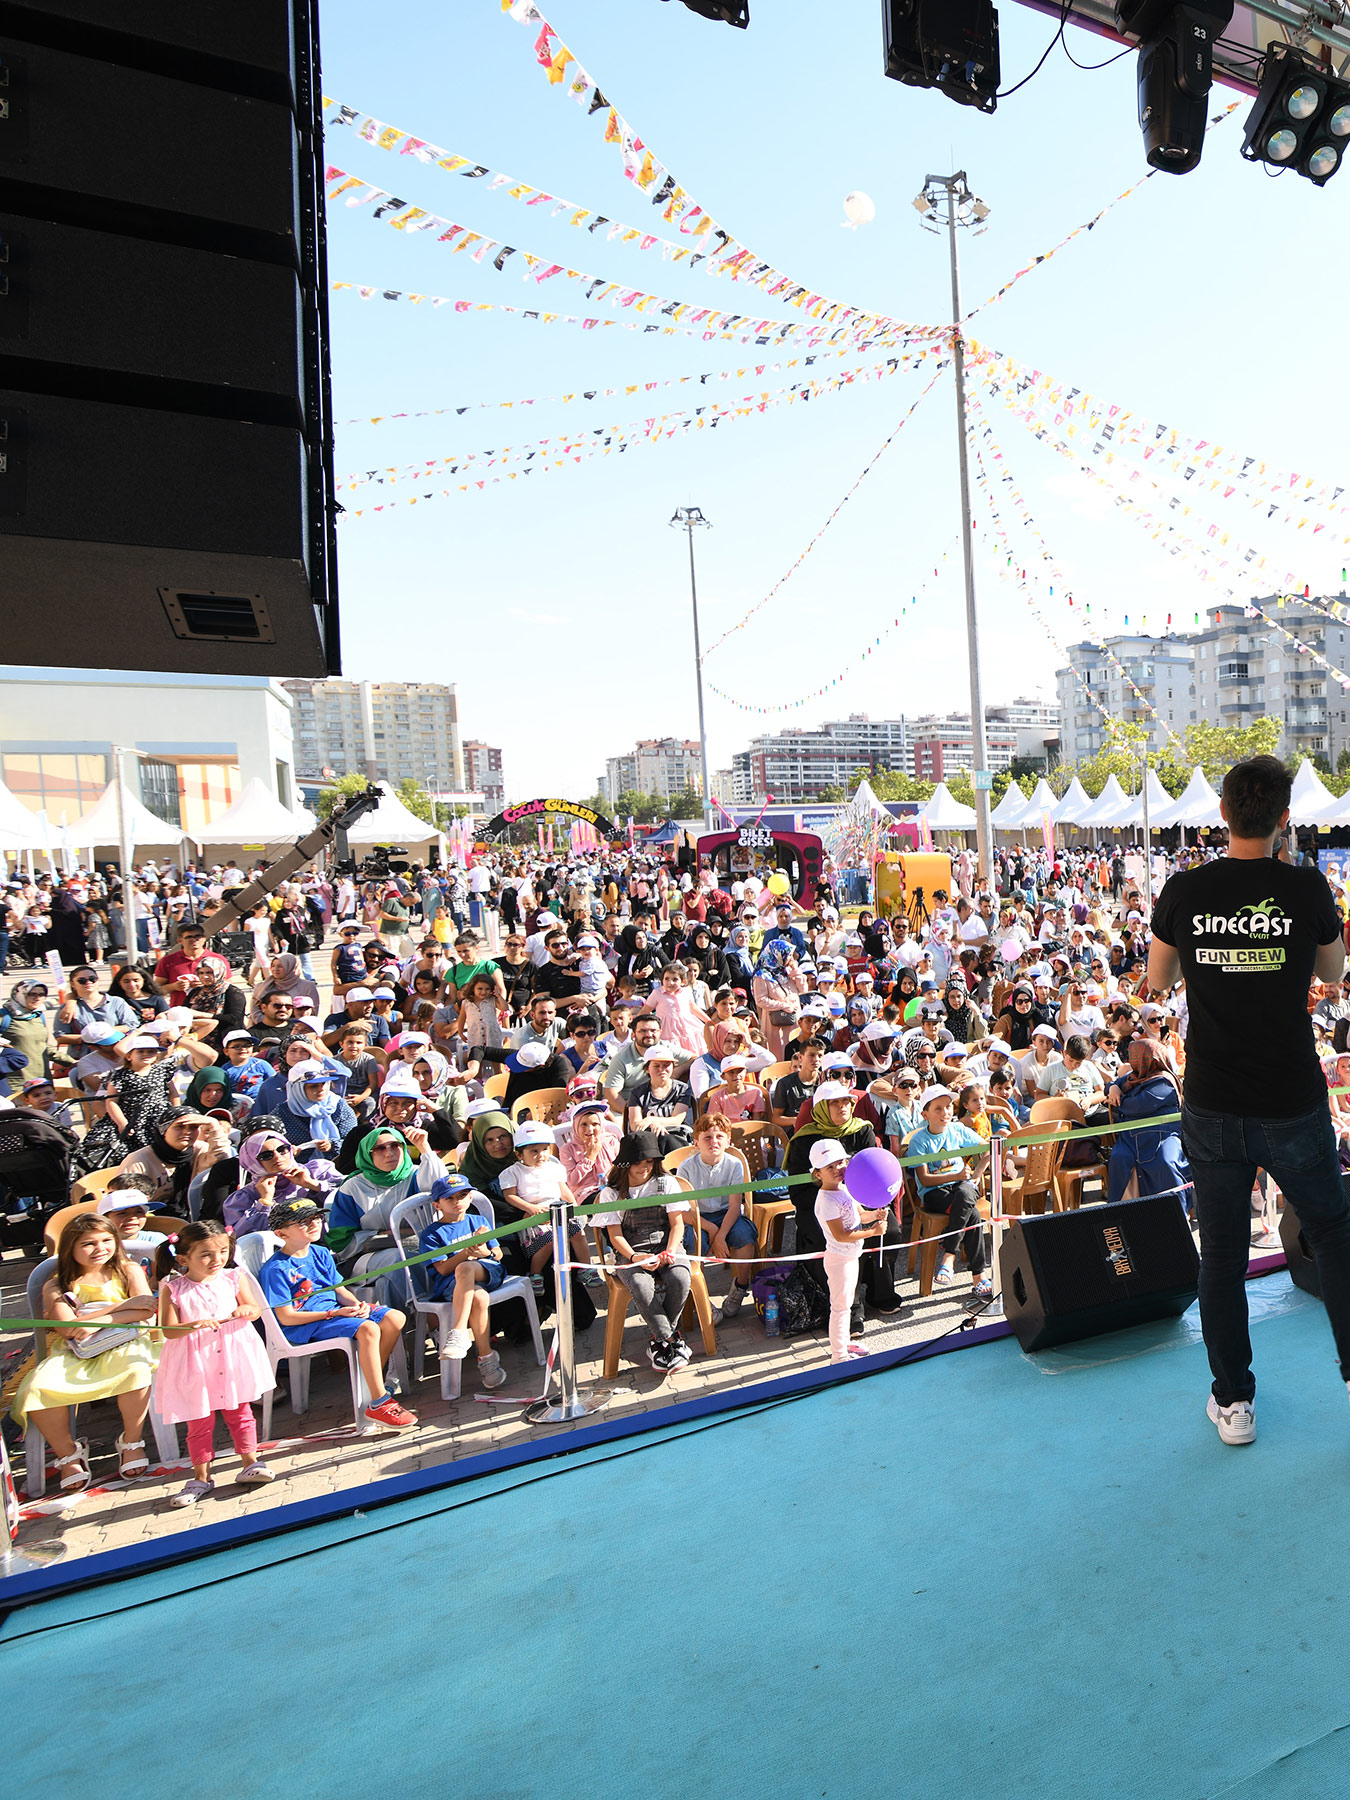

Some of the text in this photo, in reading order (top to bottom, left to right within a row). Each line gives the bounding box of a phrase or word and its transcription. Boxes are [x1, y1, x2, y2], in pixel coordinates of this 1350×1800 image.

[1193, 26, 1207, 39] 23
[977, 774, 991, 785] H2
[740, 828, 773, 838] BİLET
[737, 837, 774, 847] GİŞESİ
[1199, 949, 1283, 963] FUN CREW
[1112, 1259, 1132, 1276] BAY
